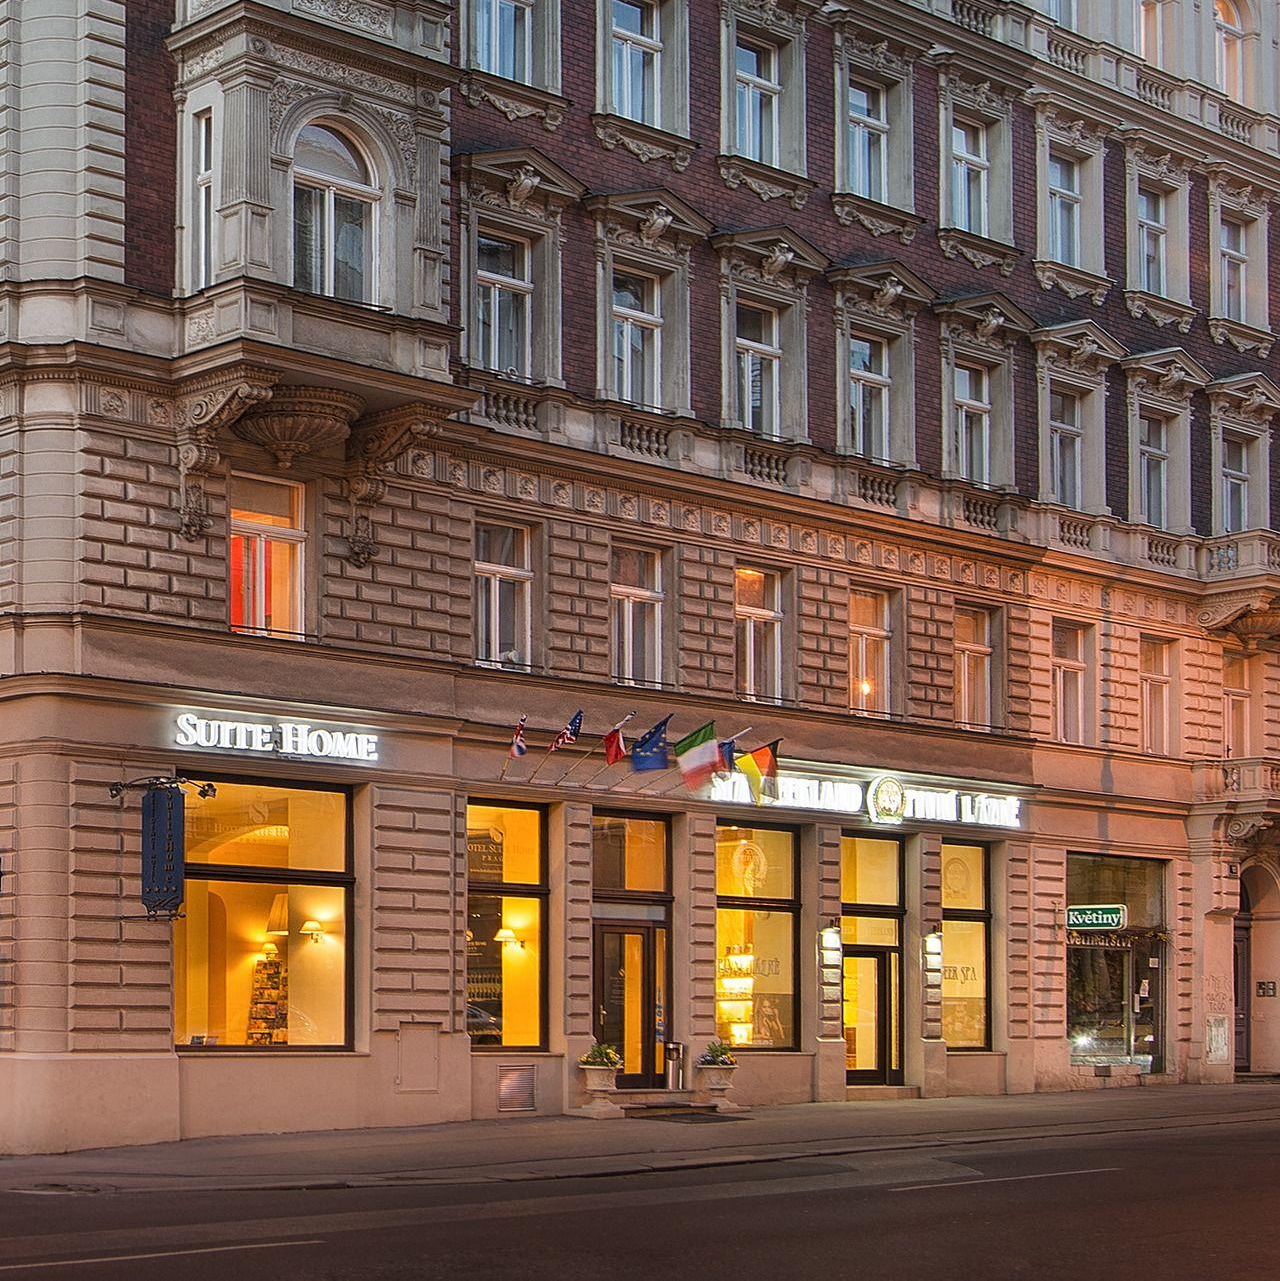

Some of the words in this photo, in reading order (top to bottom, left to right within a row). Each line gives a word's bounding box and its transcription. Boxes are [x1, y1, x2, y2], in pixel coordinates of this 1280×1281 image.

[176, 713, 274, 752] SUITE
[278, 722, 379, 761] HOME
[1068, 910, 1121, 926] Květiny
